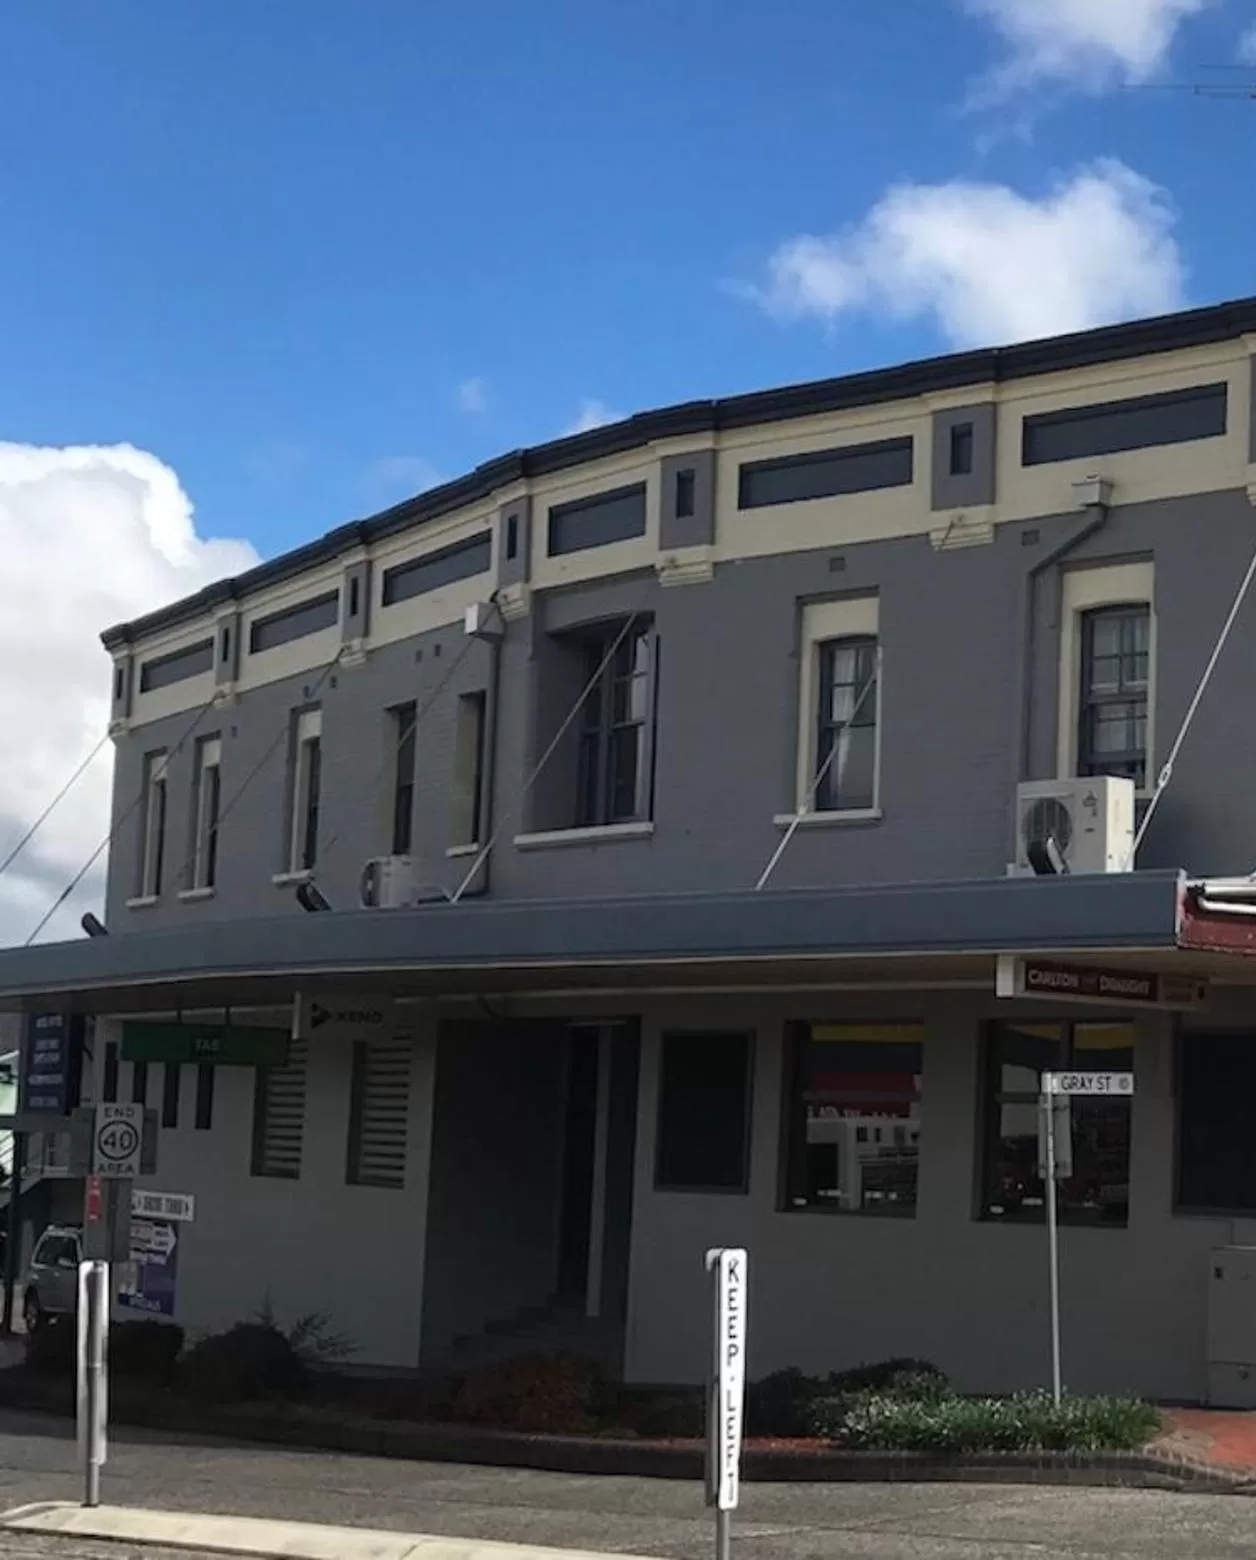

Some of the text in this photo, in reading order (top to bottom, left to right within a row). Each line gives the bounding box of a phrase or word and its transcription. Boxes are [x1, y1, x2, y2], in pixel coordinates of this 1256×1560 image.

[1060, 1074, 1113, 1091] GRAY ST
[104, 1106, 135, 1119] END
[103, 1130, 134, 1151] 40
[98, 1162, 135, 1174] AREA
[727, 1258, 740, 1367] KEEP
